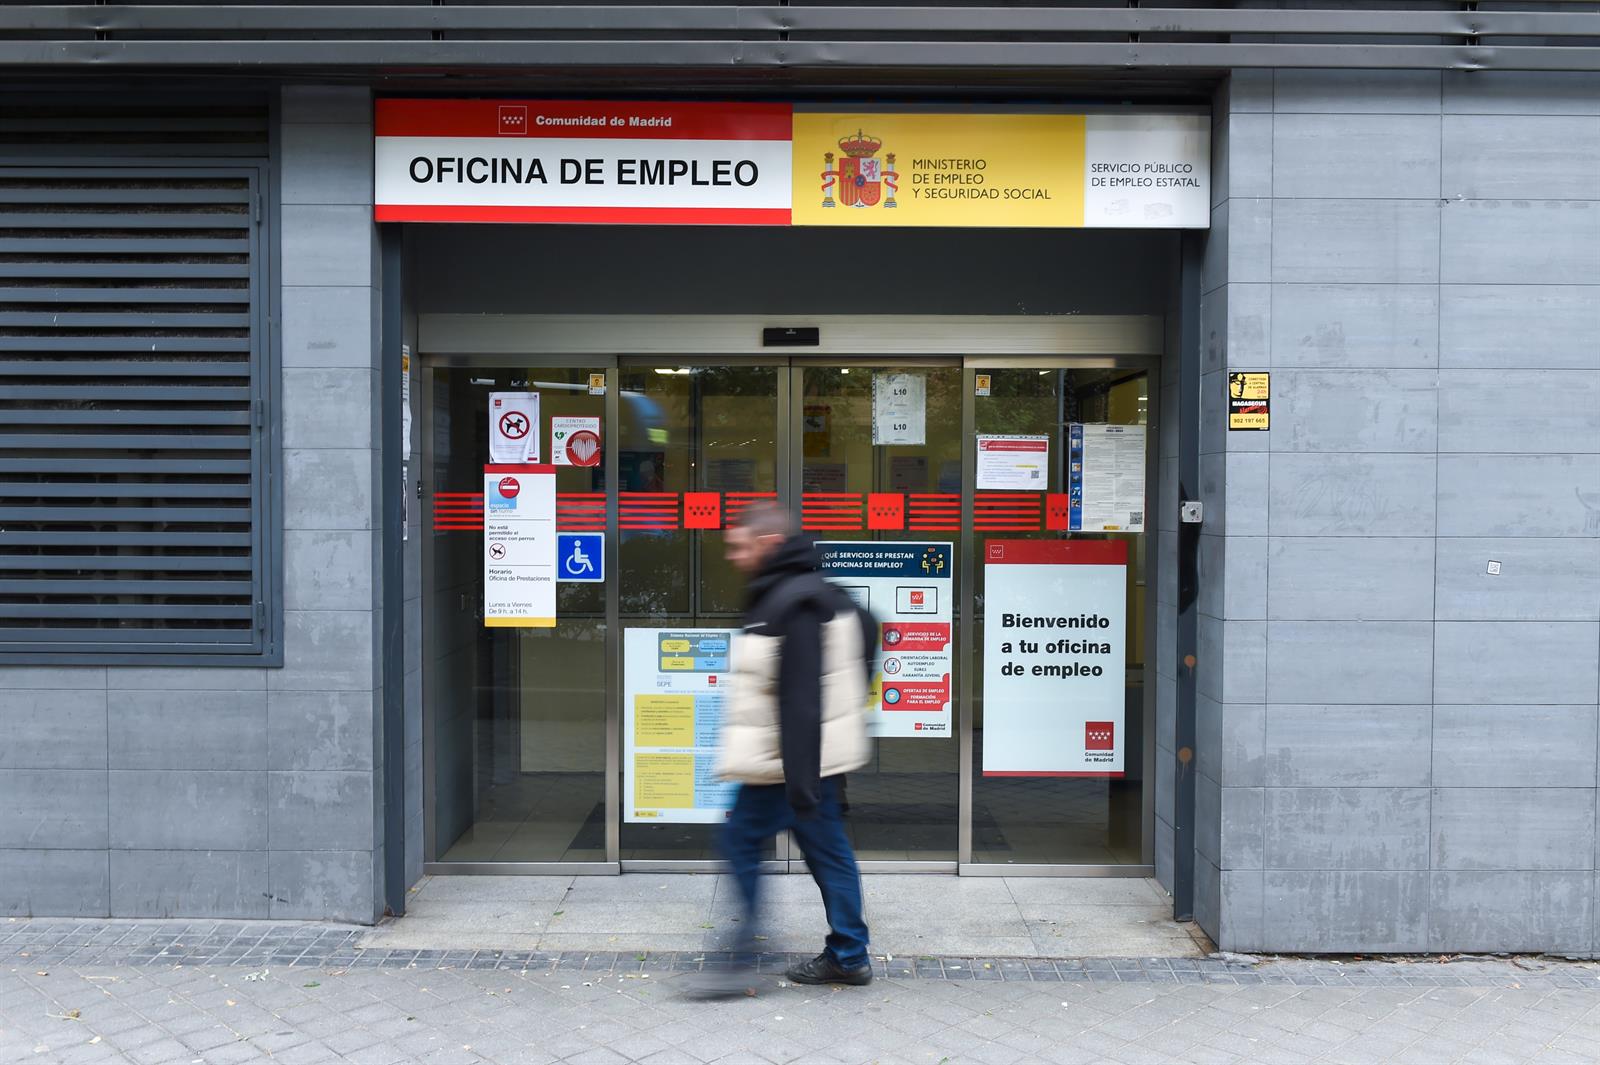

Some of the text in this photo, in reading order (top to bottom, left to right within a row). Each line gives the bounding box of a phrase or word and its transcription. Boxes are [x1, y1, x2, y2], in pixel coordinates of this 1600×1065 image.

[536, 115, 672, 128] Comunidad de Madrid
[409, 156, 760, 186] OFICINA DE EMPLEO
[912, 158, 987, 171] MINISTERIO
[1091, 160, 1193, 174] SERVICIO PÚBLICO
[912, 174, 984, 186] DE EMPLEO
[1092, 177, 1200, 188] DE EMPLEO ESTATAL
[912, 188, 1052, 200] Y SEGURIDAD SOCIAL
[1002, 614, 1110, 628] Bienvenido
[1001, 640, 1111, 654] a tu oficina
[1001, 662, 1103, 679] de empleo
